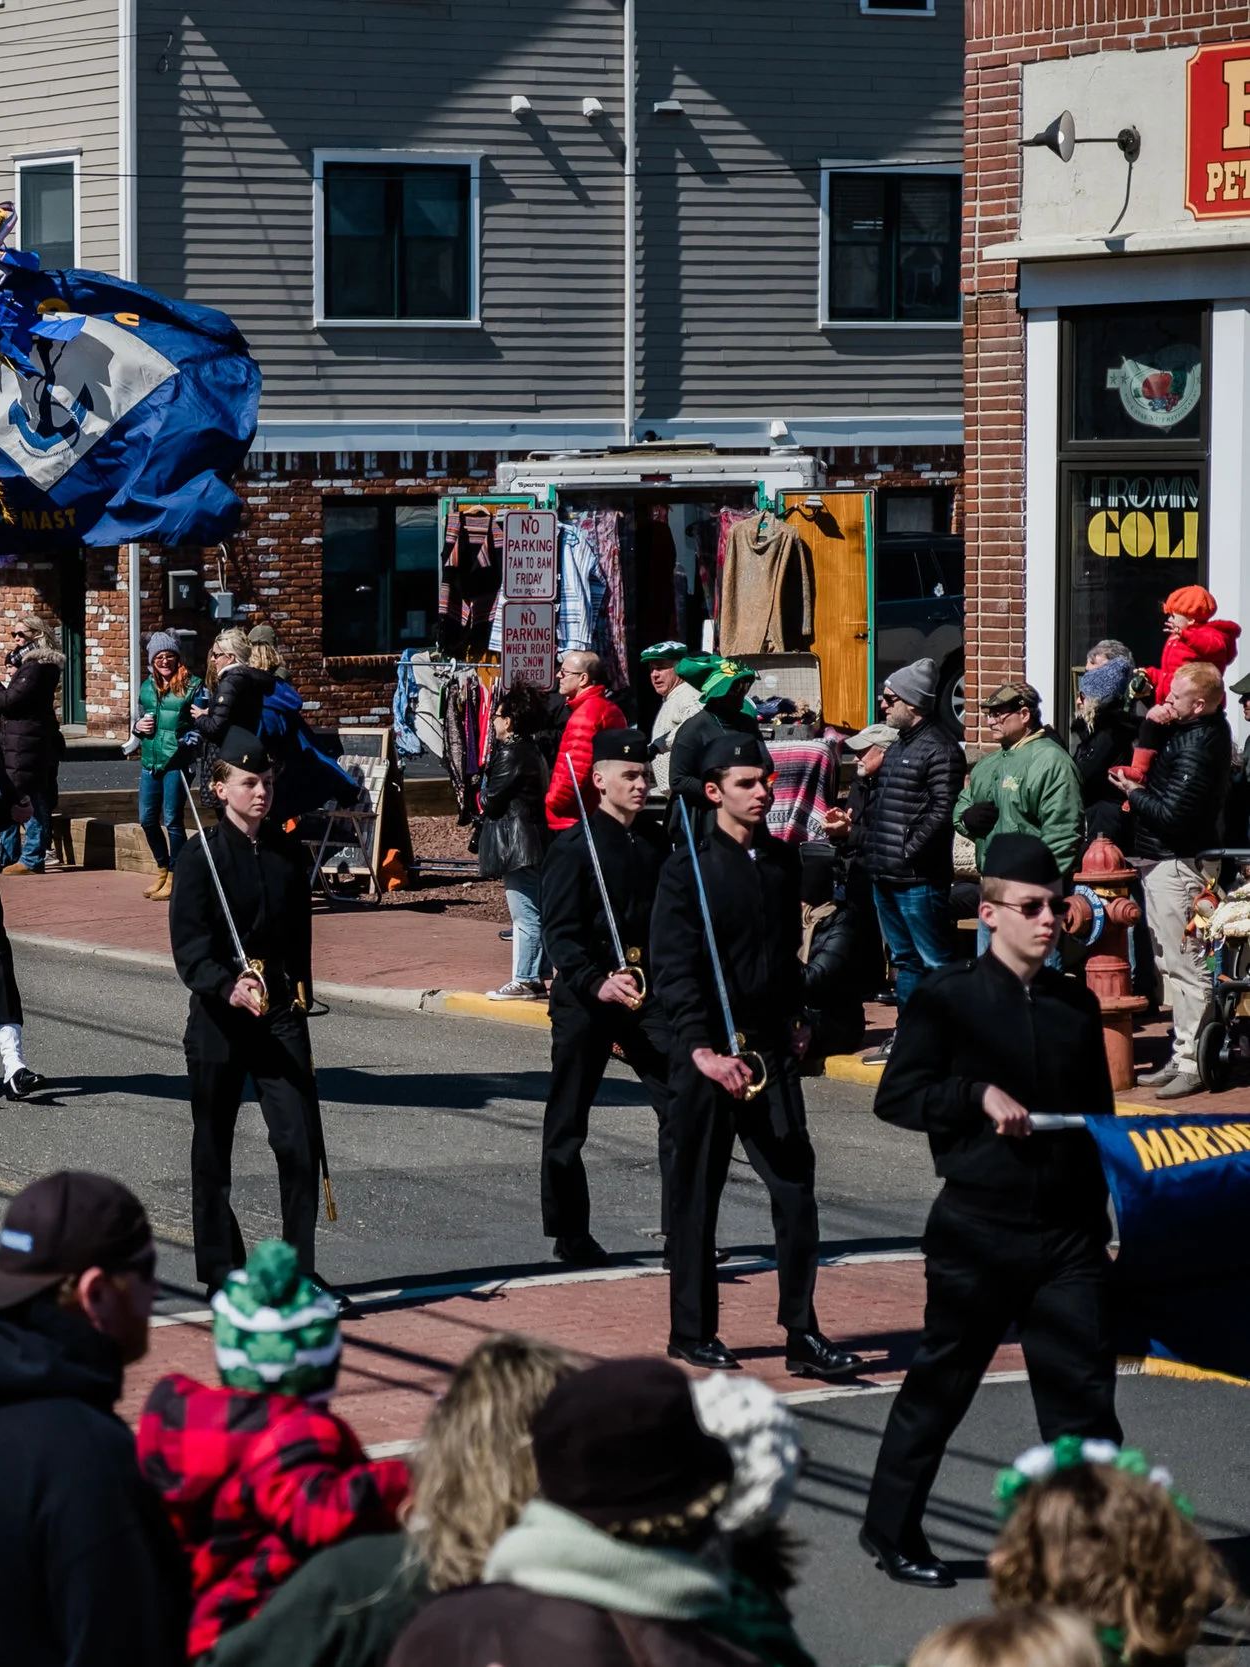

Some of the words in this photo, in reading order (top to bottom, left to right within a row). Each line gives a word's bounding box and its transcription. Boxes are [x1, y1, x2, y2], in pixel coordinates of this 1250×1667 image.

[21, 508, 76, 531] MAST
[521, 519, 540, 534] NO
[508, 539, 553, 552] PARKING
[509, 557, 523, 569] 7AM
[526, 557, 535, 569] TO
[537, 557, 552, 569] 8AM
[515, 573, 543, 585] FRIDAY
[520, 611, 536, 626] NO
[506, 628, 551, 641] PARKING
[506, 643, 527, 655] WHEN
[530, 643, 551, 655] ROAD
[512, 656, 519, 668] IS
[523, 656, 544, 668] SNOW
[511, 669, 545, 681] COVERED
